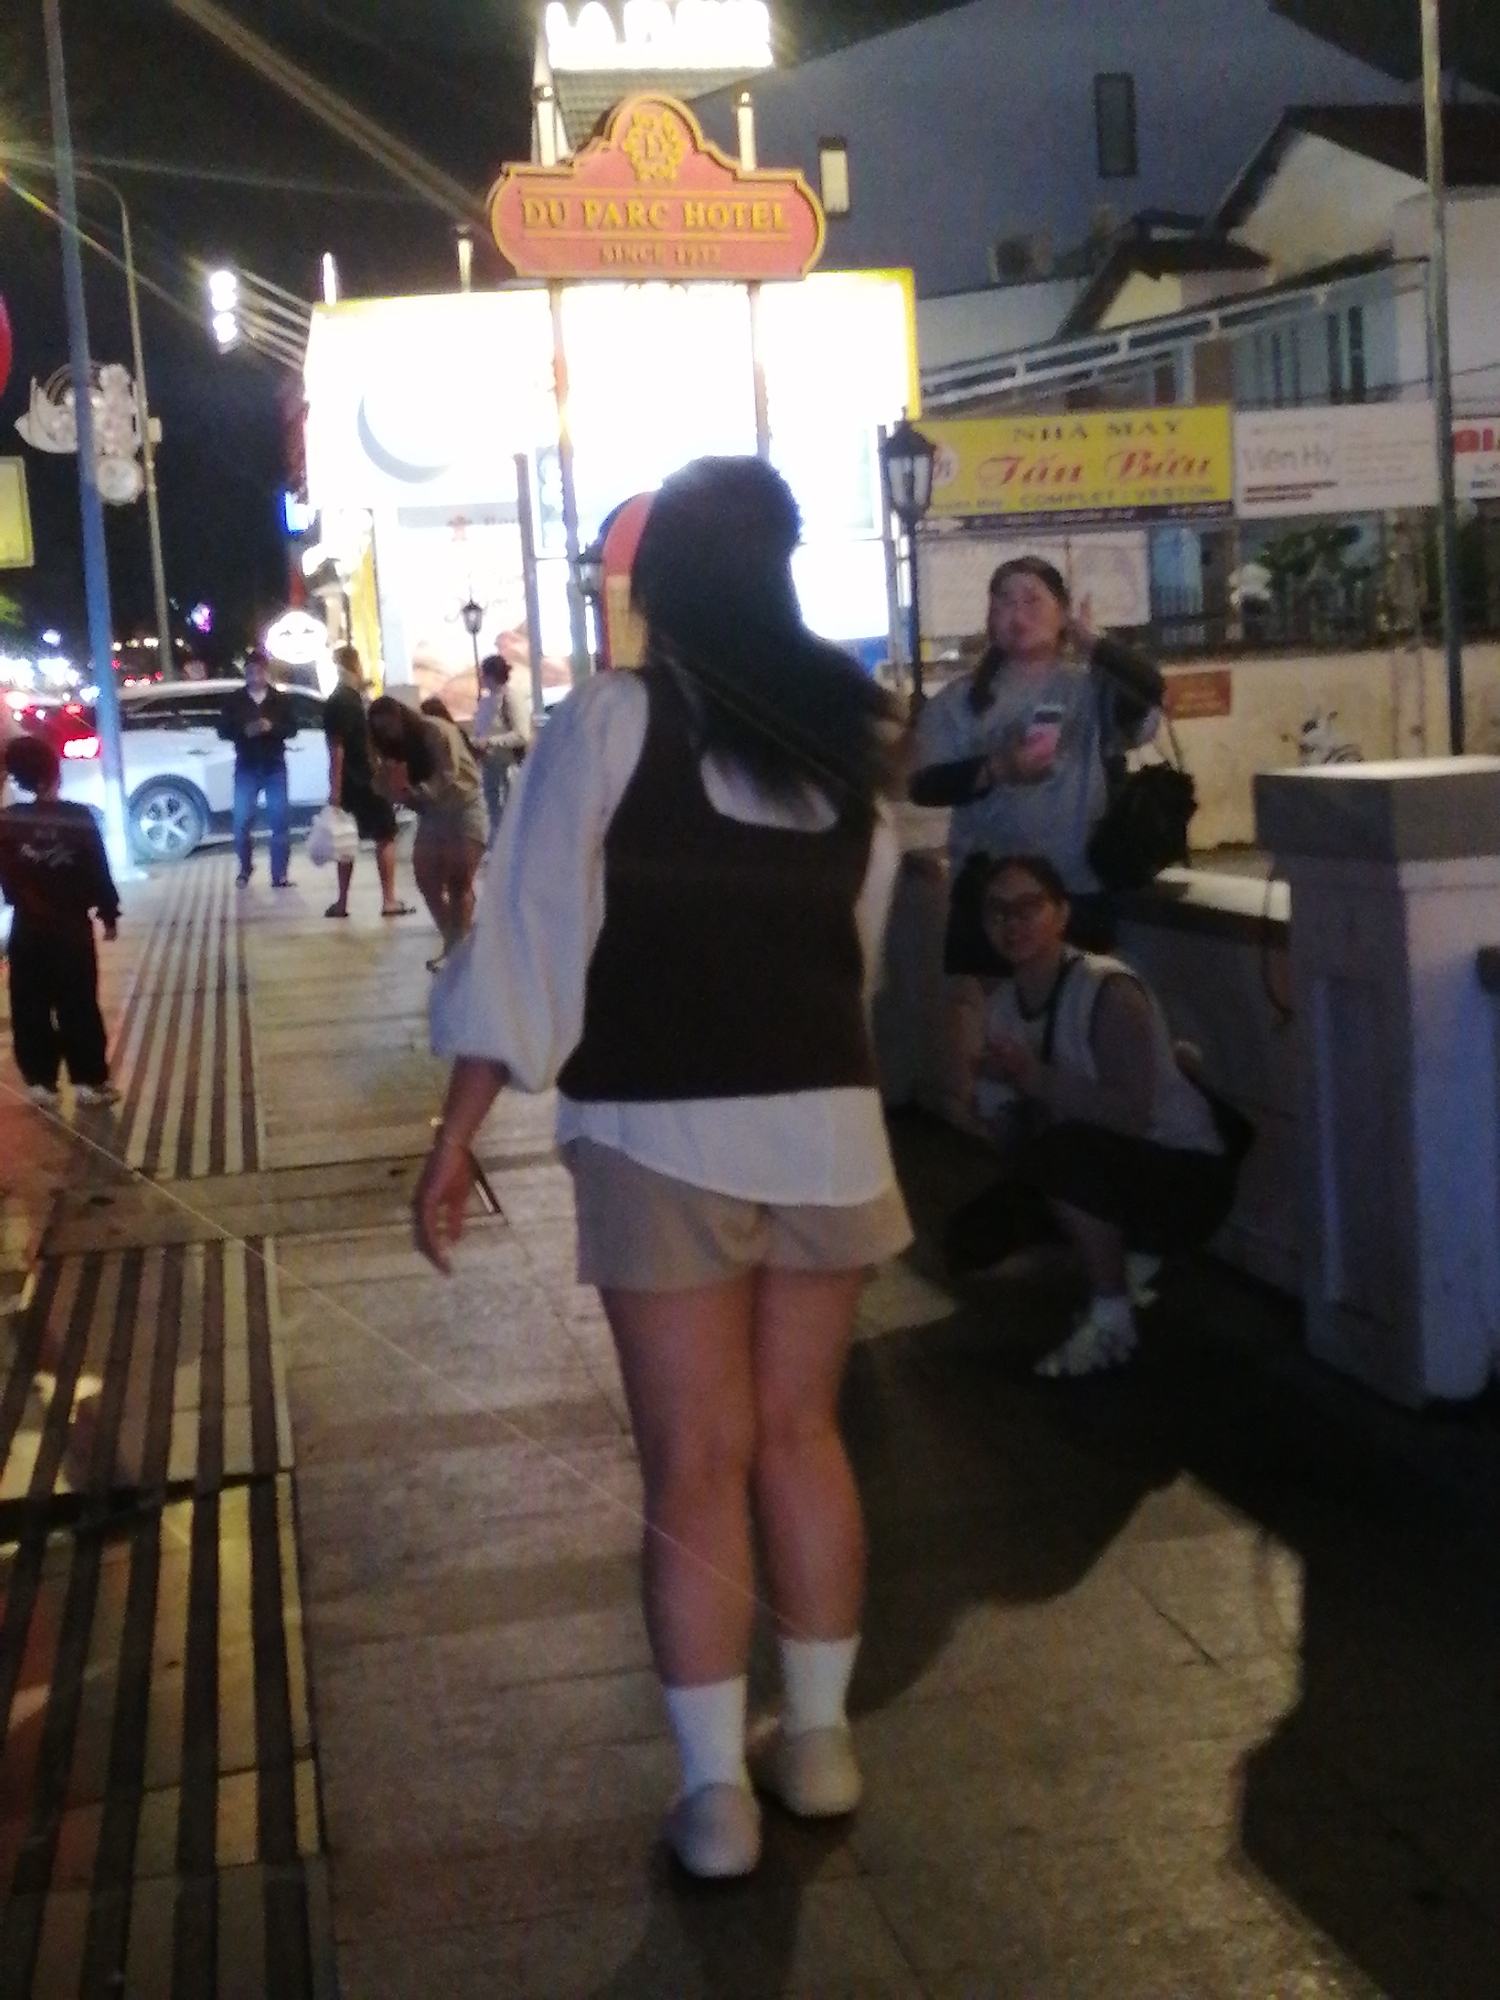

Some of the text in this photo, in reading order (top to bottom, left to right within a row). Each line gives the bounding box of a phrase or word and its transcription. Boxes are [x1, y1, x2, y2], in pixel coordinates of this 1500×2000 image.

[523, 199, 790, 231] DU PARC HOTEL
